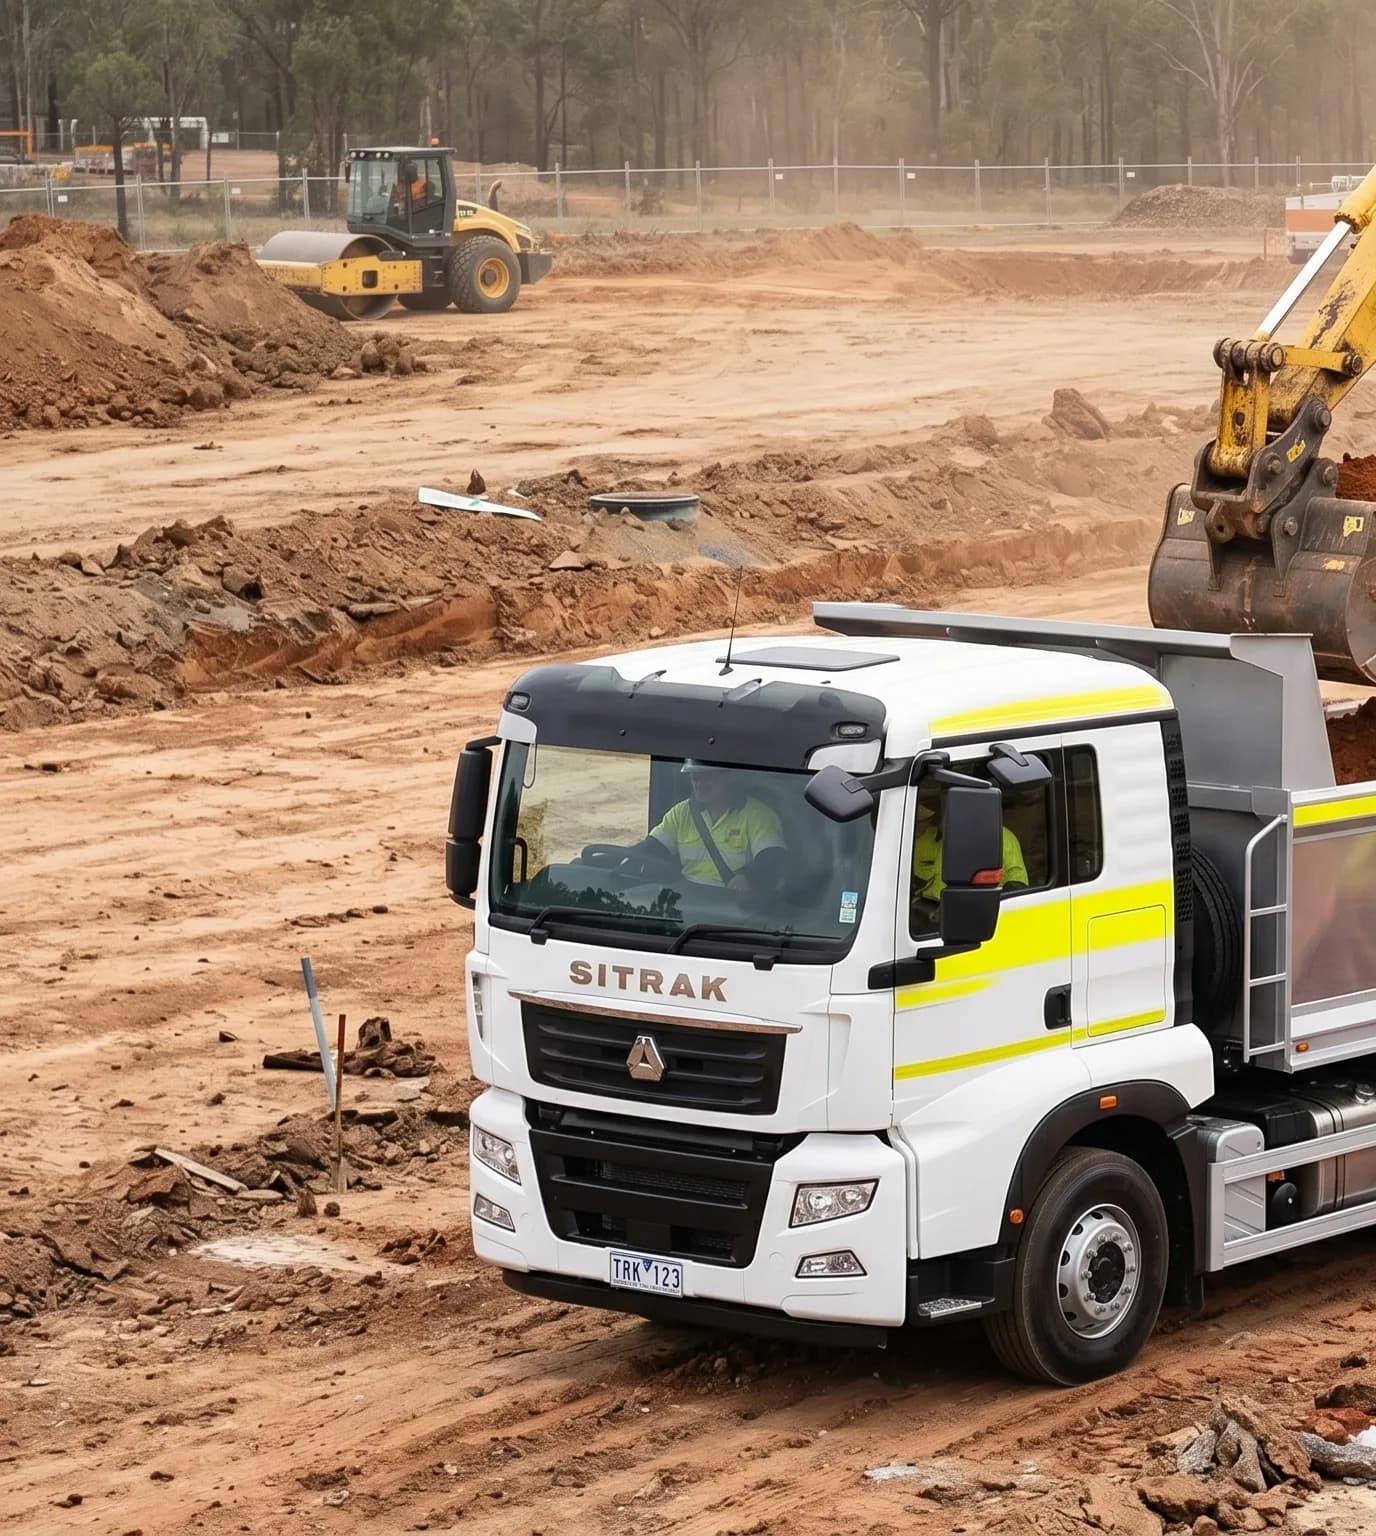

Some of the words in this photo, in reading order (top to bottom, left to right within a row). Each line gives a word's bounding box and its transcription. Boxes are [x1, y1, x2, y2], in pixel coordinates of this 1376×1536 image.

[569, 960, 727, 1002] SITRAK
[613, 1258, 641, 1283] TRK
[654, 1265, 680, 1289] 123
